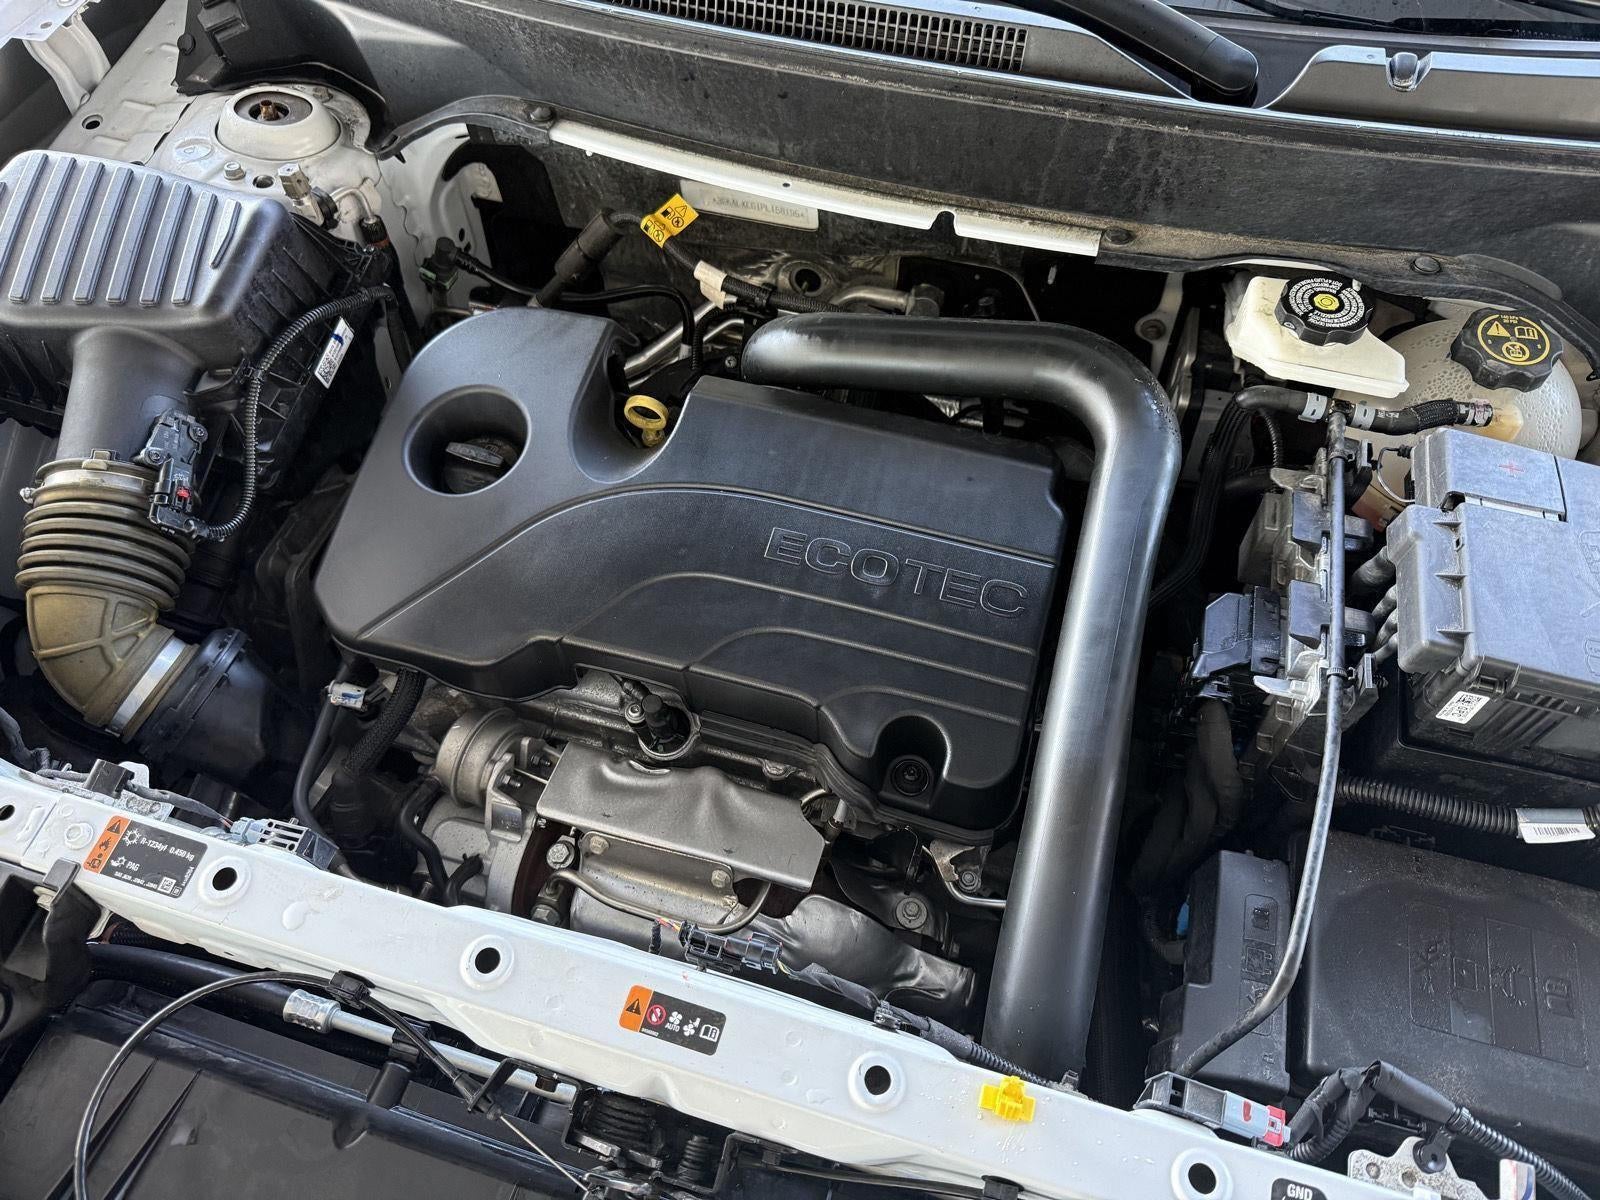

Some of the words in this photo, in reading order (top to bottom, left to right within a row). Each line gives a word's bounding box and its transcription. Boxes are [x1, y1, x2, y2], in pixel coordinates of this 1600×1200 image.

[764, 526, 1028, 618] ECOTEC
[140, 838, 168, 852] R-1234yf
[186, 850, 195, 861] kg
[126, 861, 140, 872] PAG
[664, 1023, 680, 1032] AUTO
[1286, 1183, 1313, 1200] GND
